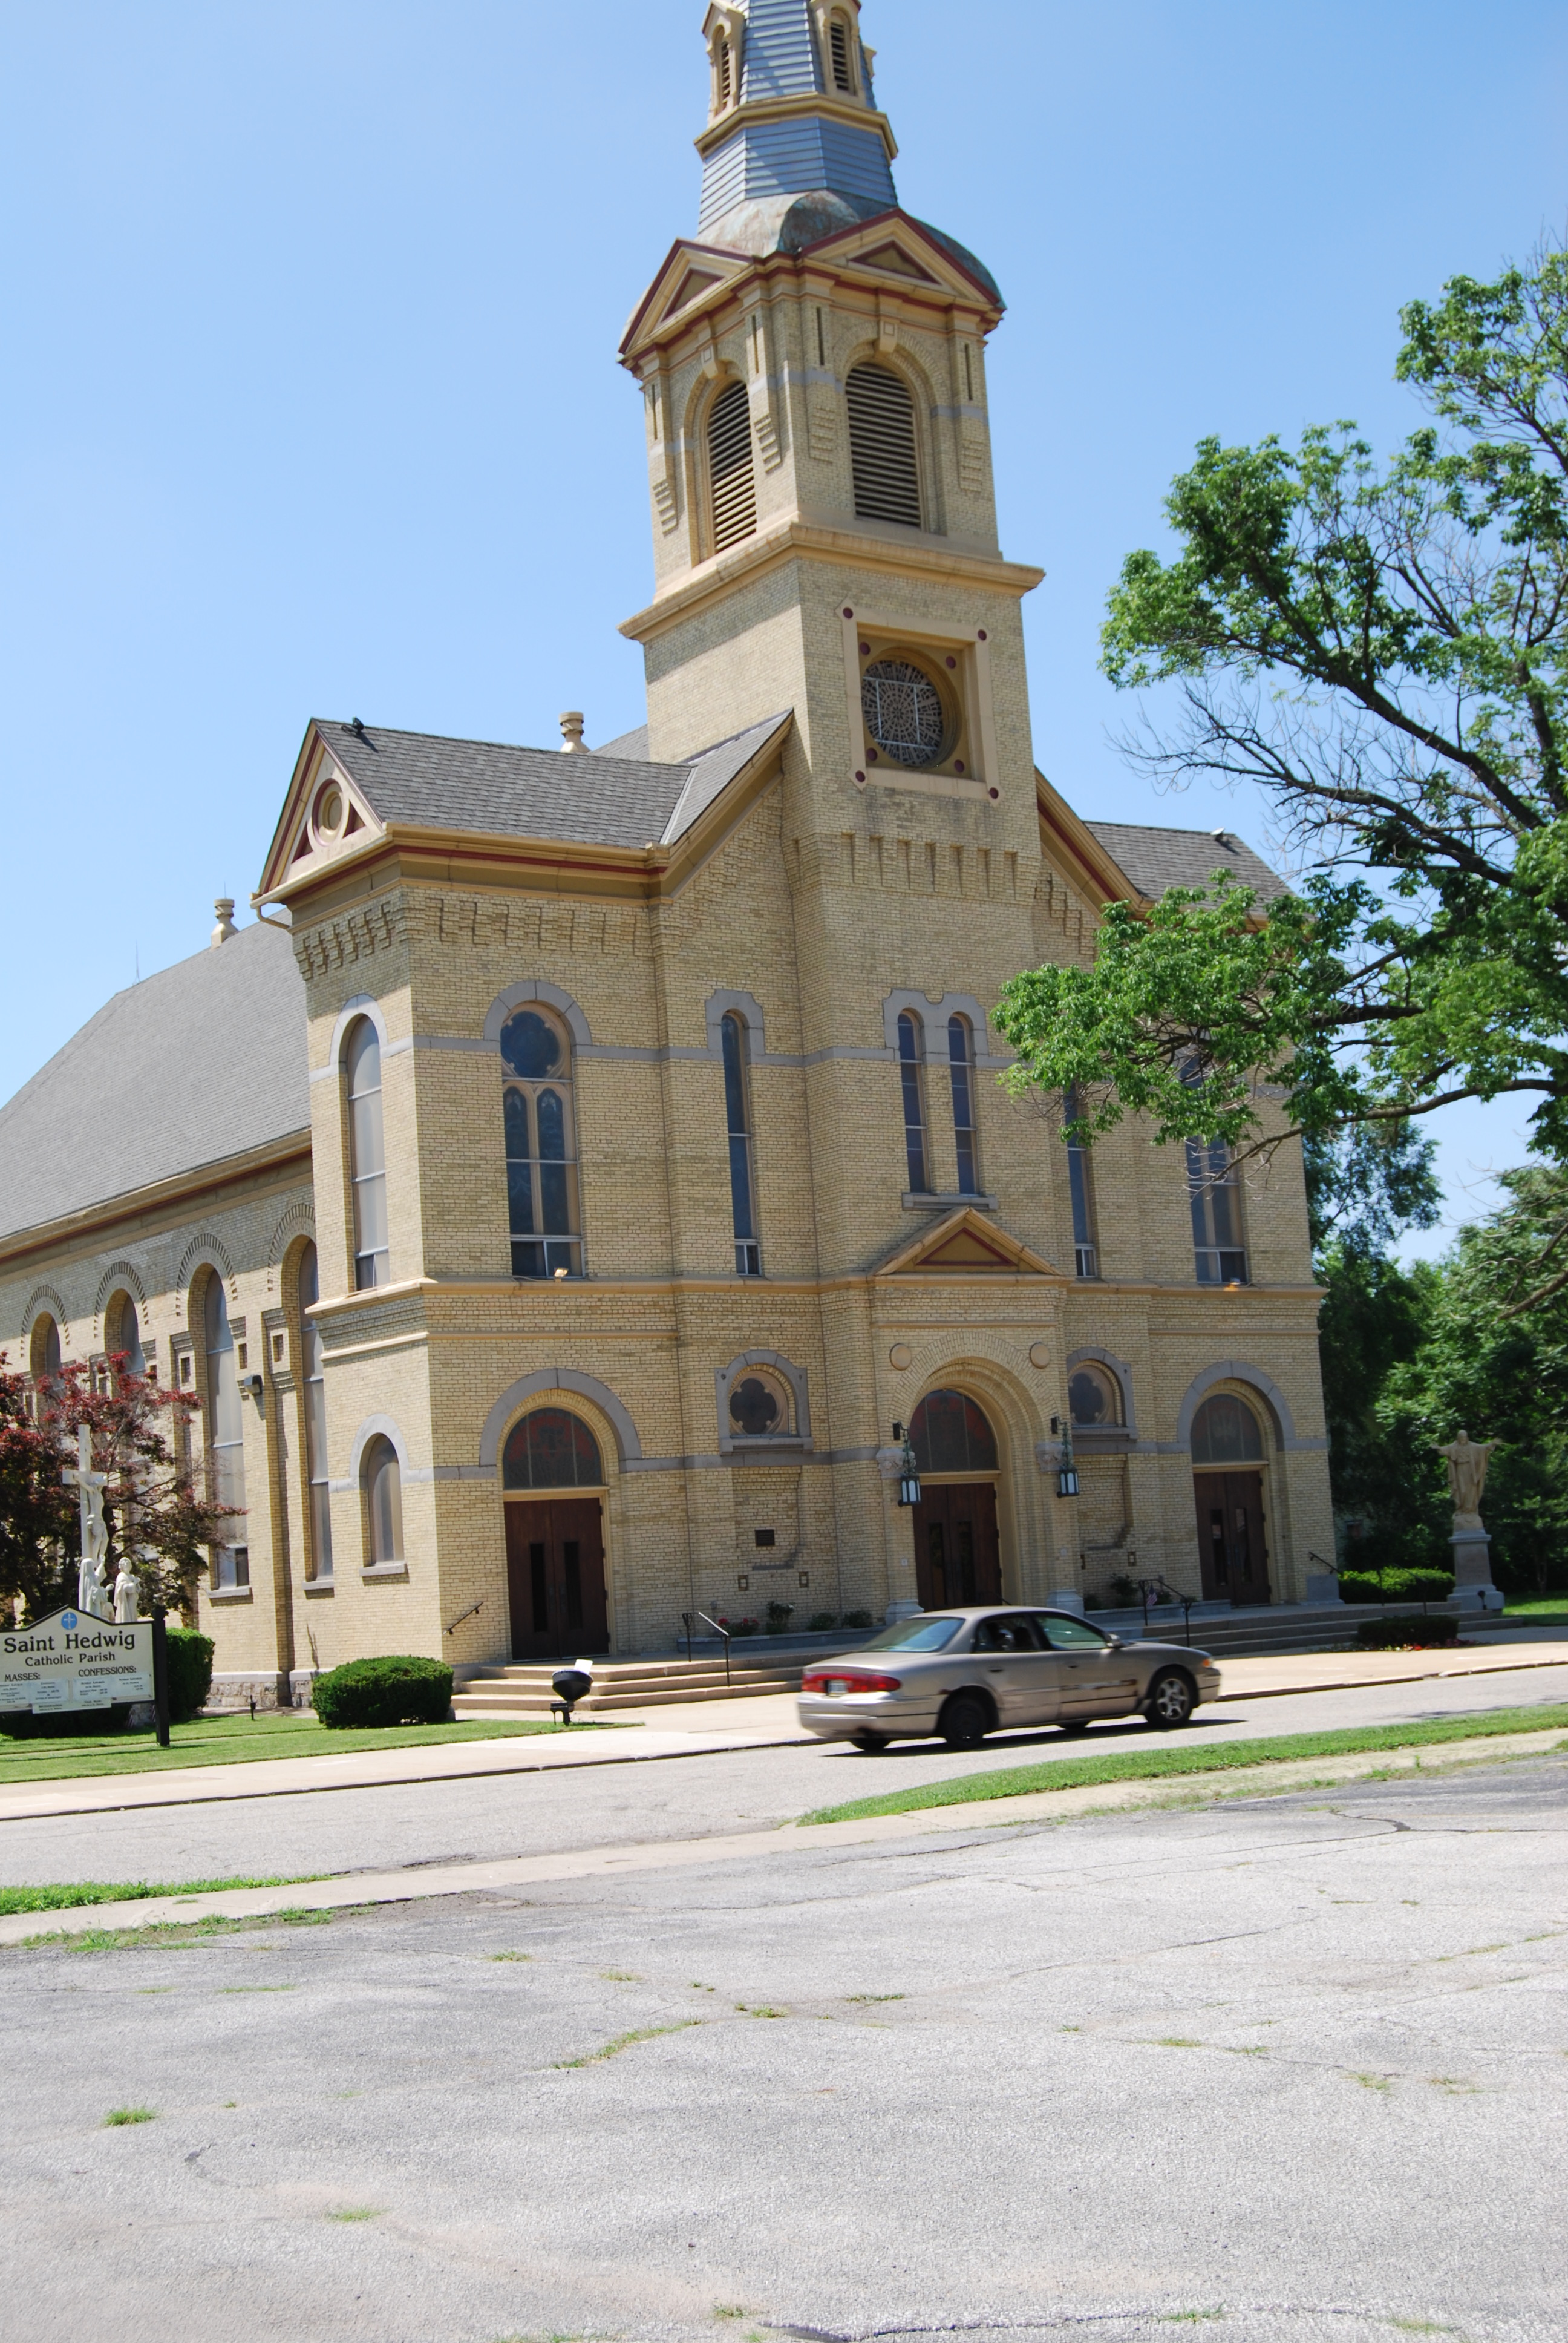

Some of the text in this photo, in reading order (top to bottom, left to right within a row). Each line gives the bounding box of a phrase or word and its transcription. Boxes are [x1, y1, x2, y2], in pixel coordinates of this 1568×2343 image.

[4, 1631, 135, 1653] Saint Hedwig
[25, 1652, 116, 1666] Catholic Parish
[5, 1673, 41, 1682] MASSES:
[79, 1666, 137, 1677] CONFESSIONS:
